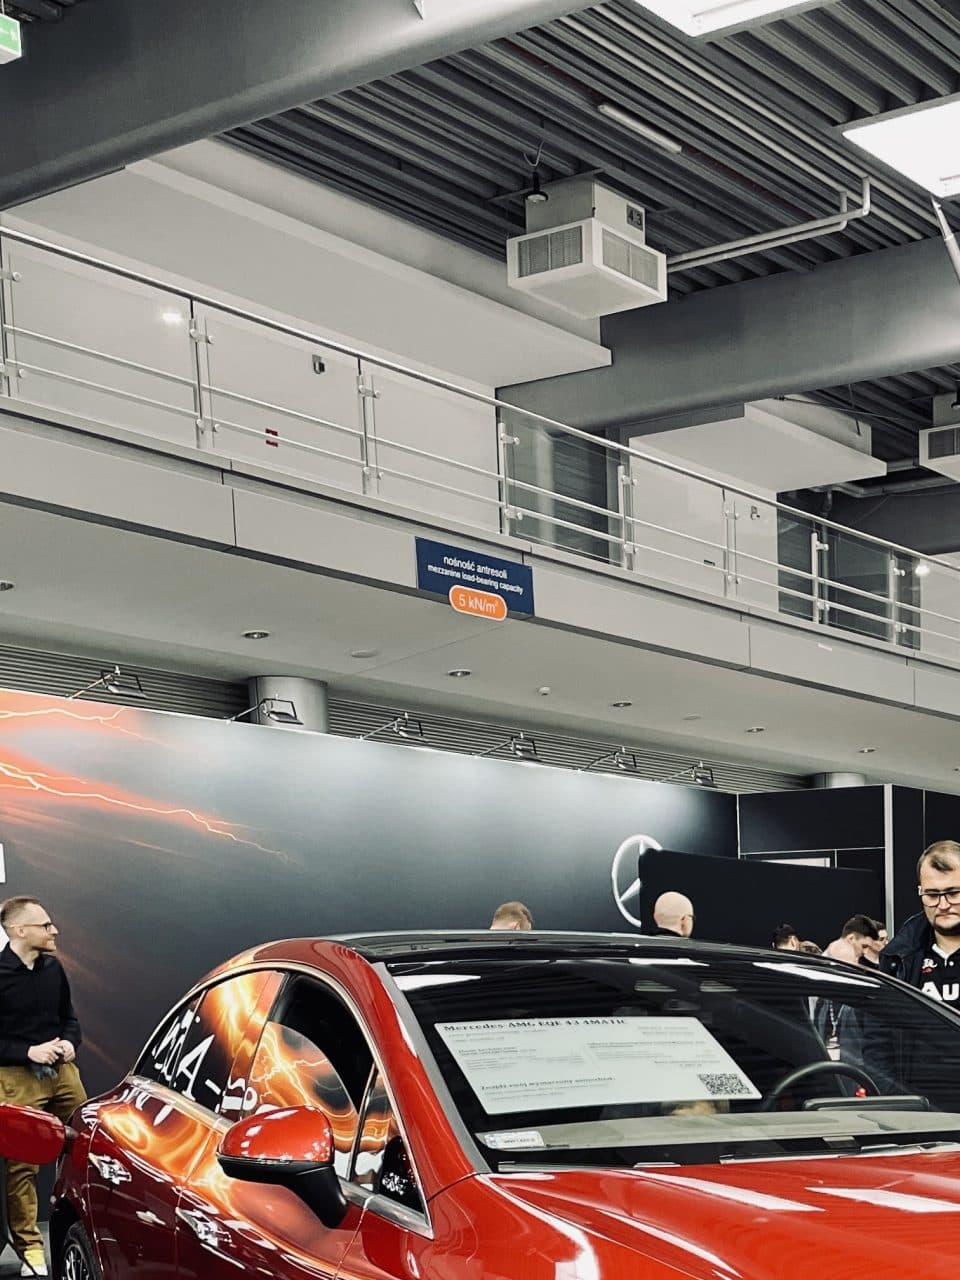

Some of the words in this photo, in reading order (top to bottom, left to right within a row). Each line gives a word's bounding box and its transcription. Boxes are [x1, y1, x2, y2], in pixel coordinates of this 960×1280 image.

[443, 555, 475, 571] nośność
[476, 564, 508, 579] antresoli
[427, 564, 461, 579] mezzanine
[461, 571, 499, 590] load-bearing
[499, 581, 524, 595] capacity
[458, 593, 466, 607] 5
